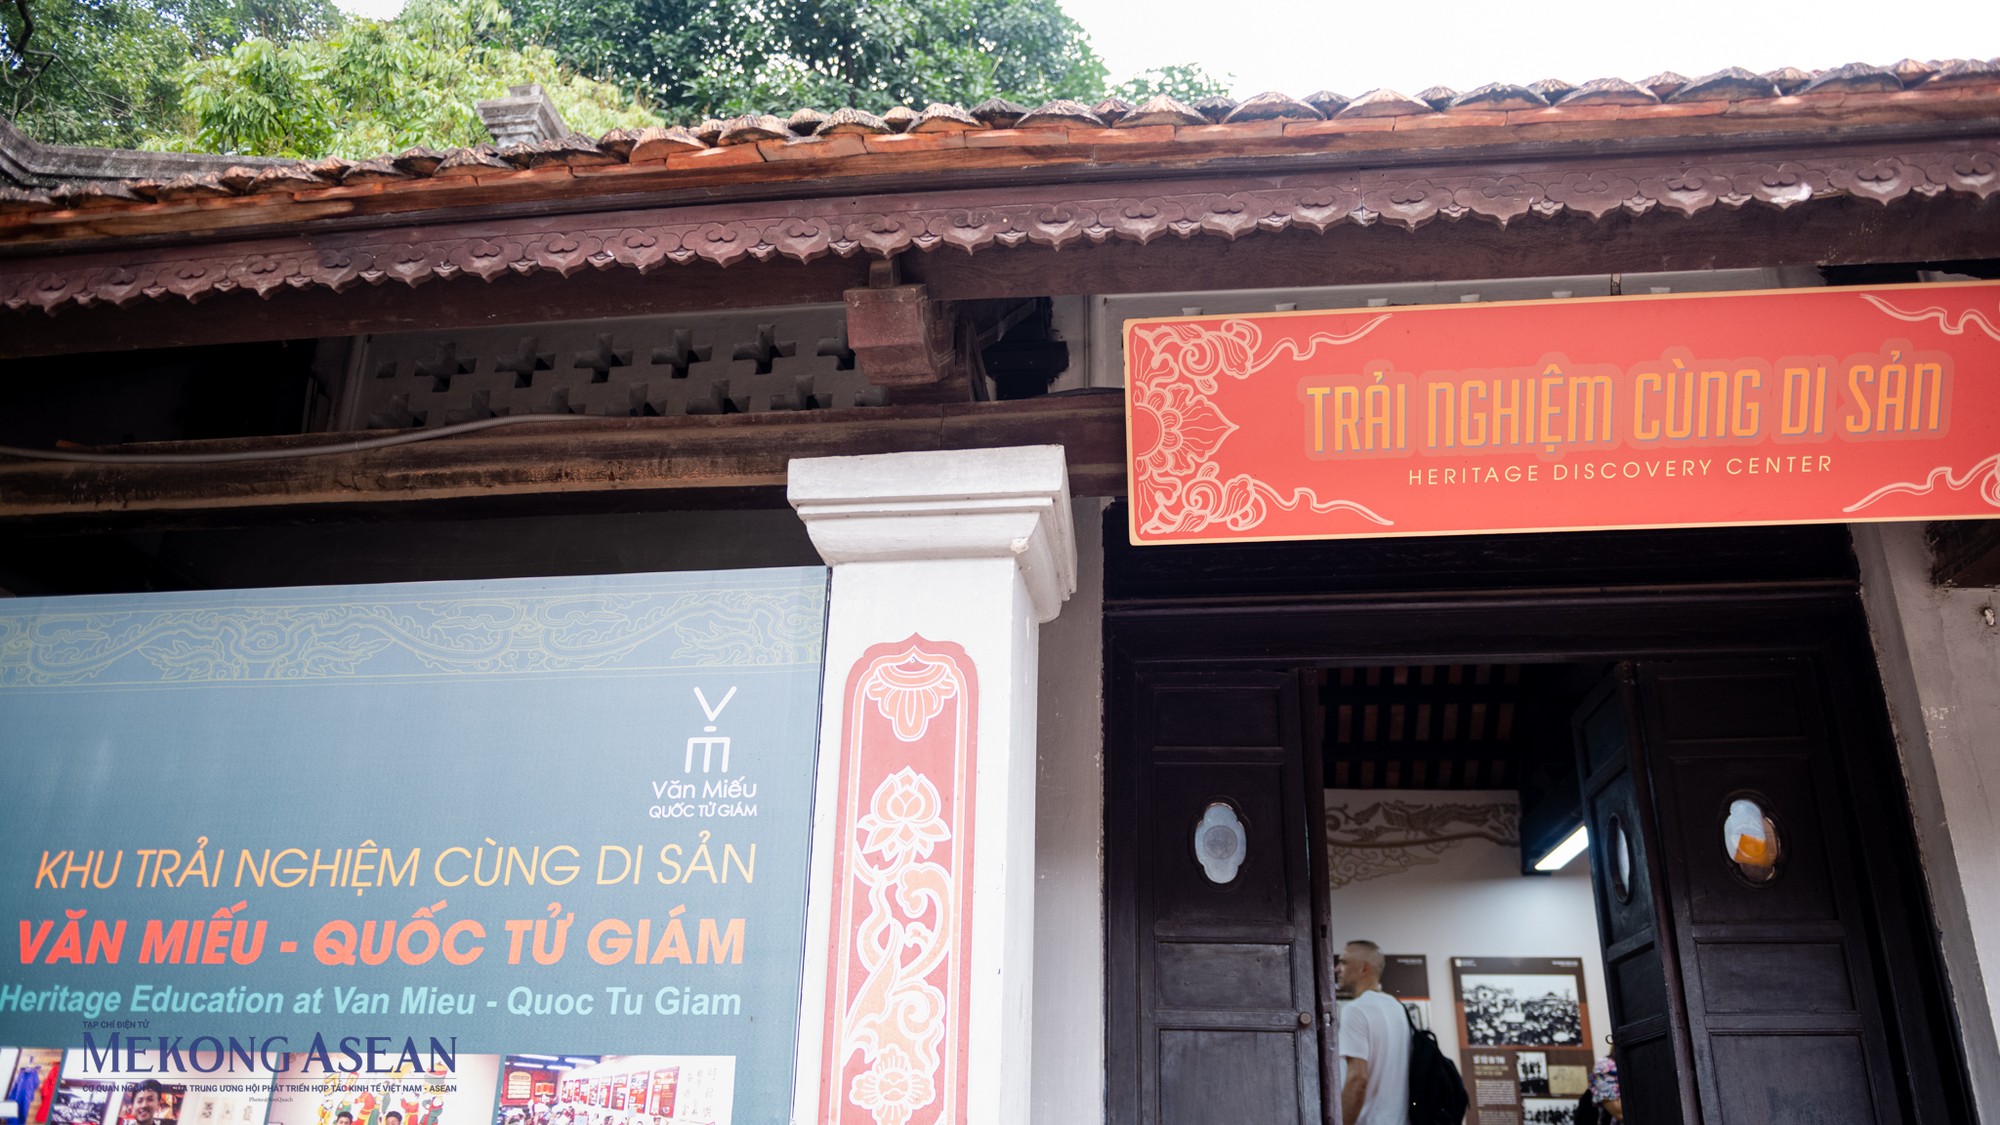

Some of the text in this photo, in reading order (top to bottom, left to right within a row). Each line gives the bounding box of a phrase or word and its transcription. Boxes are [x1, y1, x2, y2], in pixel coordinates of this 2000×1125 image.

[1306, 350, 1943, 454] TRẢI NGHIỆM CÙNG DI SẢN
[1408, 455, 1832, 486] HERITAGE DISCOVERY CENTER
[652, 775, 758, 799] Văn Miếu
[649, 800, 758, 818] QUỐC TỬ GIÁM
[34, 830, 757, 897] KHU TRẢI NGHIỆM CÙNG DI SẢN
[19, 908, 127, 965] VĂN
[138, 899, 268, 965] MIẾU
[313, 899, 487, 966] QUỐC
[504, 902, 575, 966] TỬ
[586, 904, 746, 966] GIÁM
[0, 984, 121, 1019] Heritage
[130, 984, 284, 1014] Education
[293, 986, 323, 1014] at
[333, 986, 390, 1014] Van
[400, 986, 476, 1015] Mieu
[507, 986, 594, 1017] Quoc
[605, 986, 644, 1016] Tu
[654, 986, 742, 1016] Giam
